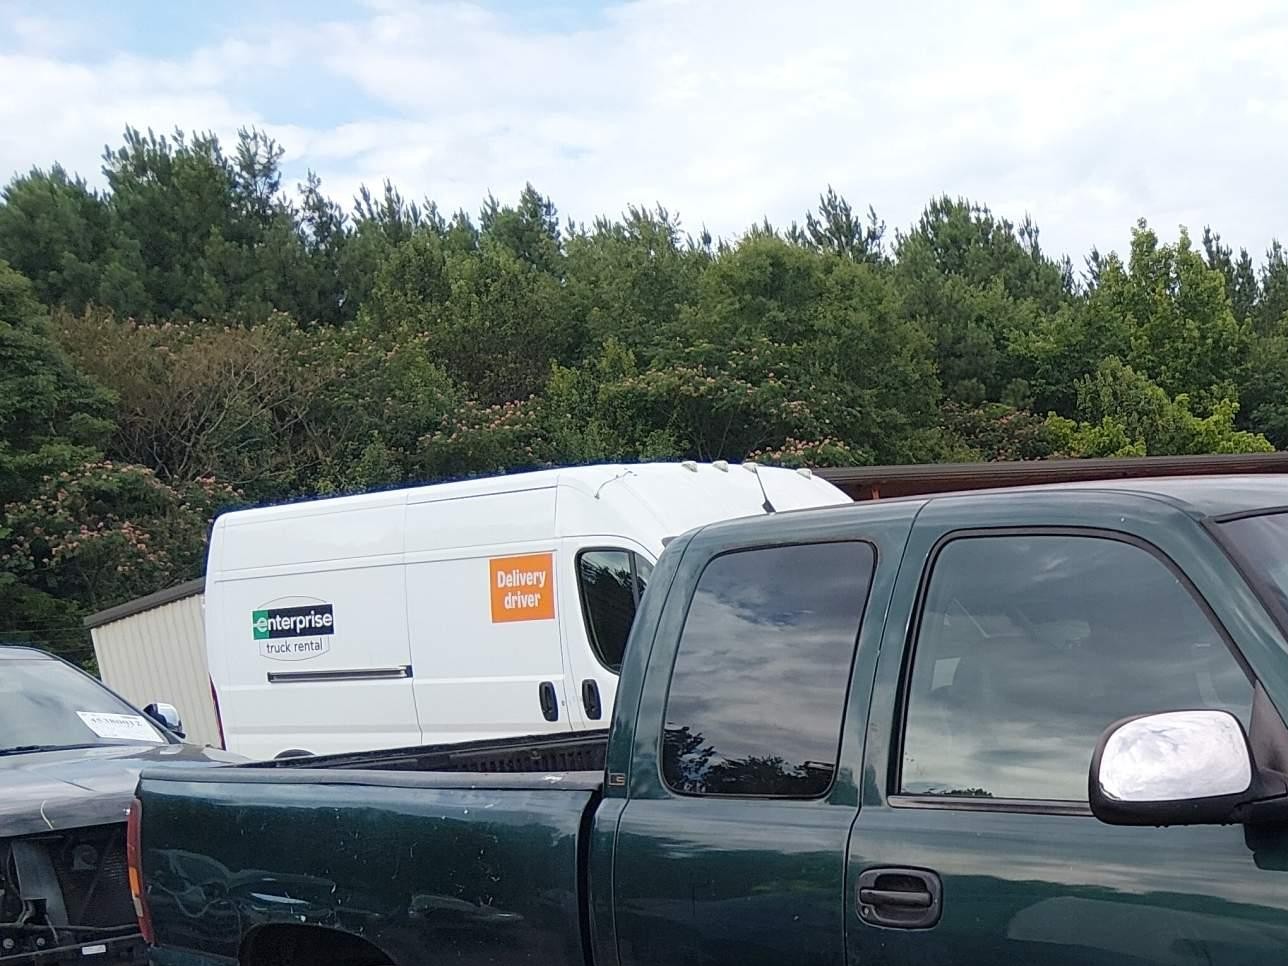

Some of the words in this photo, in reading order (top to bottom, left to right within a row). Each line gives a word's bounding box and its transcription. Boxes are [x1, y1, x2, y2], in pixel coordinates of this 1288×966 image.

[497, 569, 546, 588] Delivery
[504, 591, 541, 609] driver
[254, 610, 333, 634] enterprise
[266, 640, 291, 654] truck
[294, 637, 323, 652] rental
